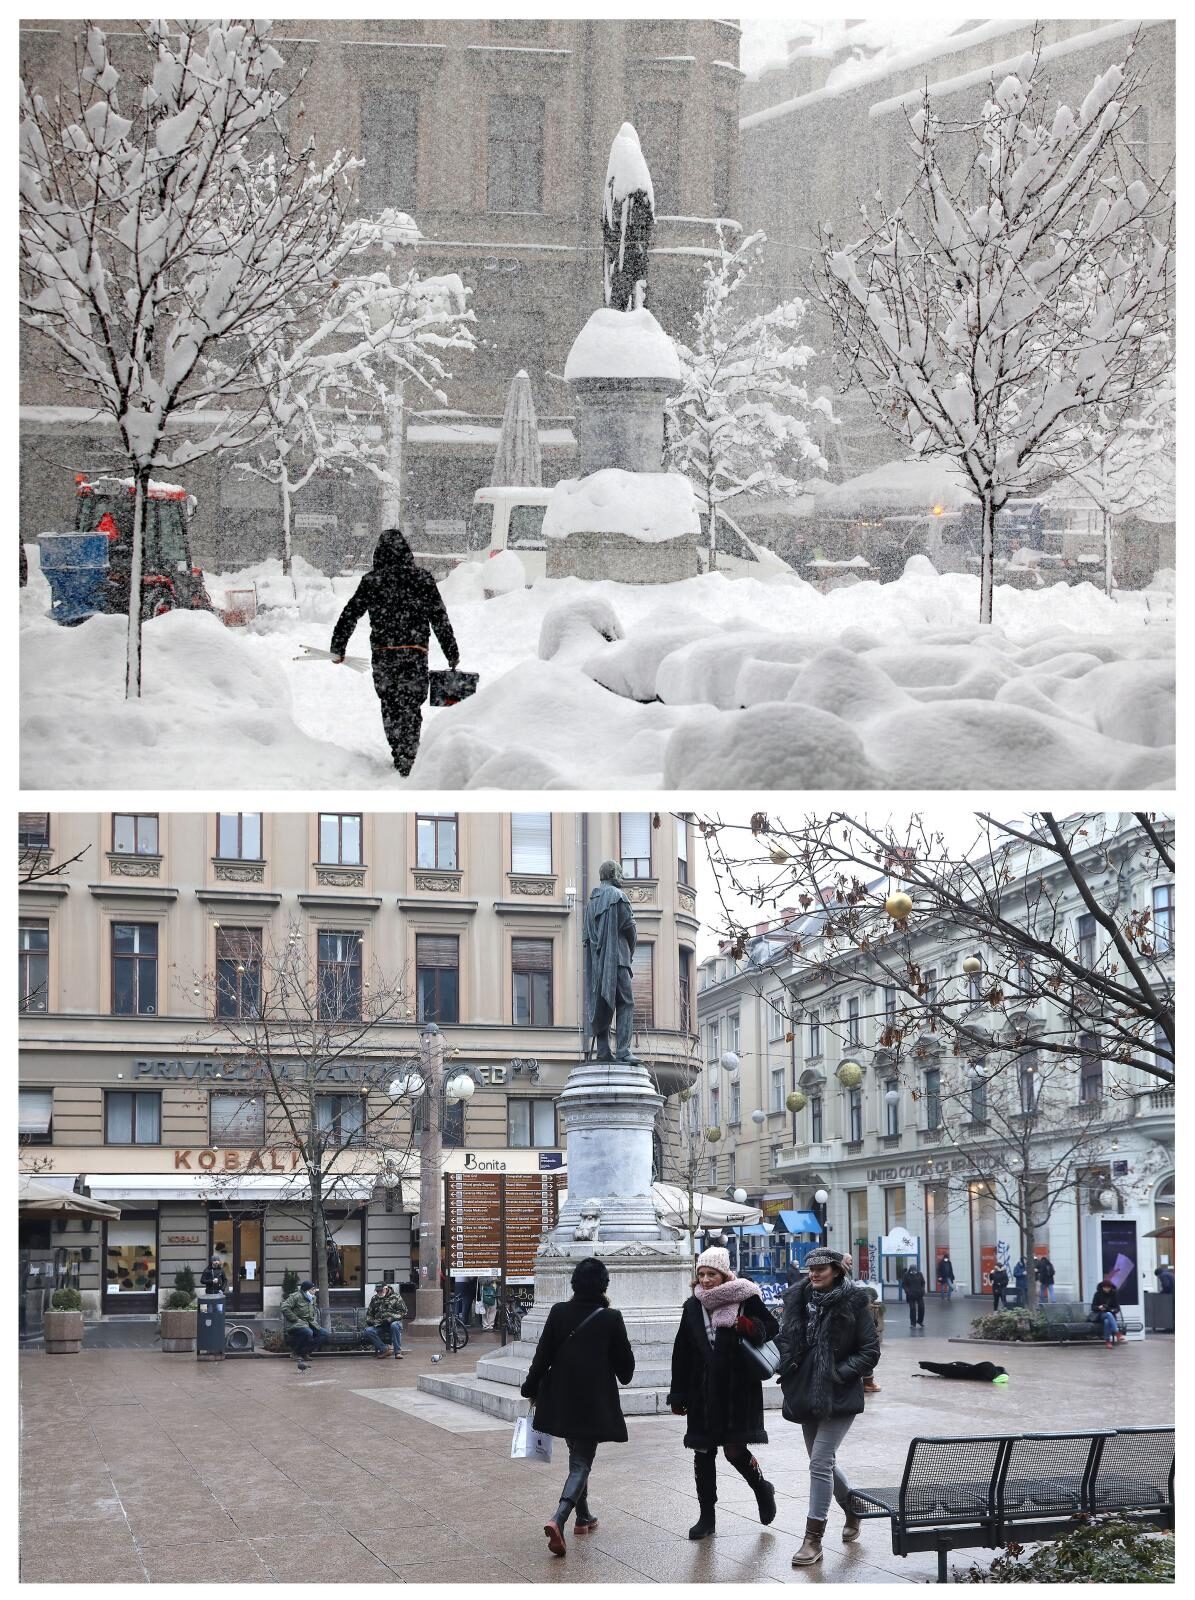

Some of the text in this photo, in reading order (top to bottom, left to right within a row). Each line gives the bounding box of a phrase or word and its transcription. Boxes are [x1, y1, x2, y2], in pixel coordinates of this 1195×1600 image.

[174, 1150, 298, 1170] KOBALI
[464, 1153, 506, 1170] Bonita
[866, 1168, 897, 1182] UNITED
